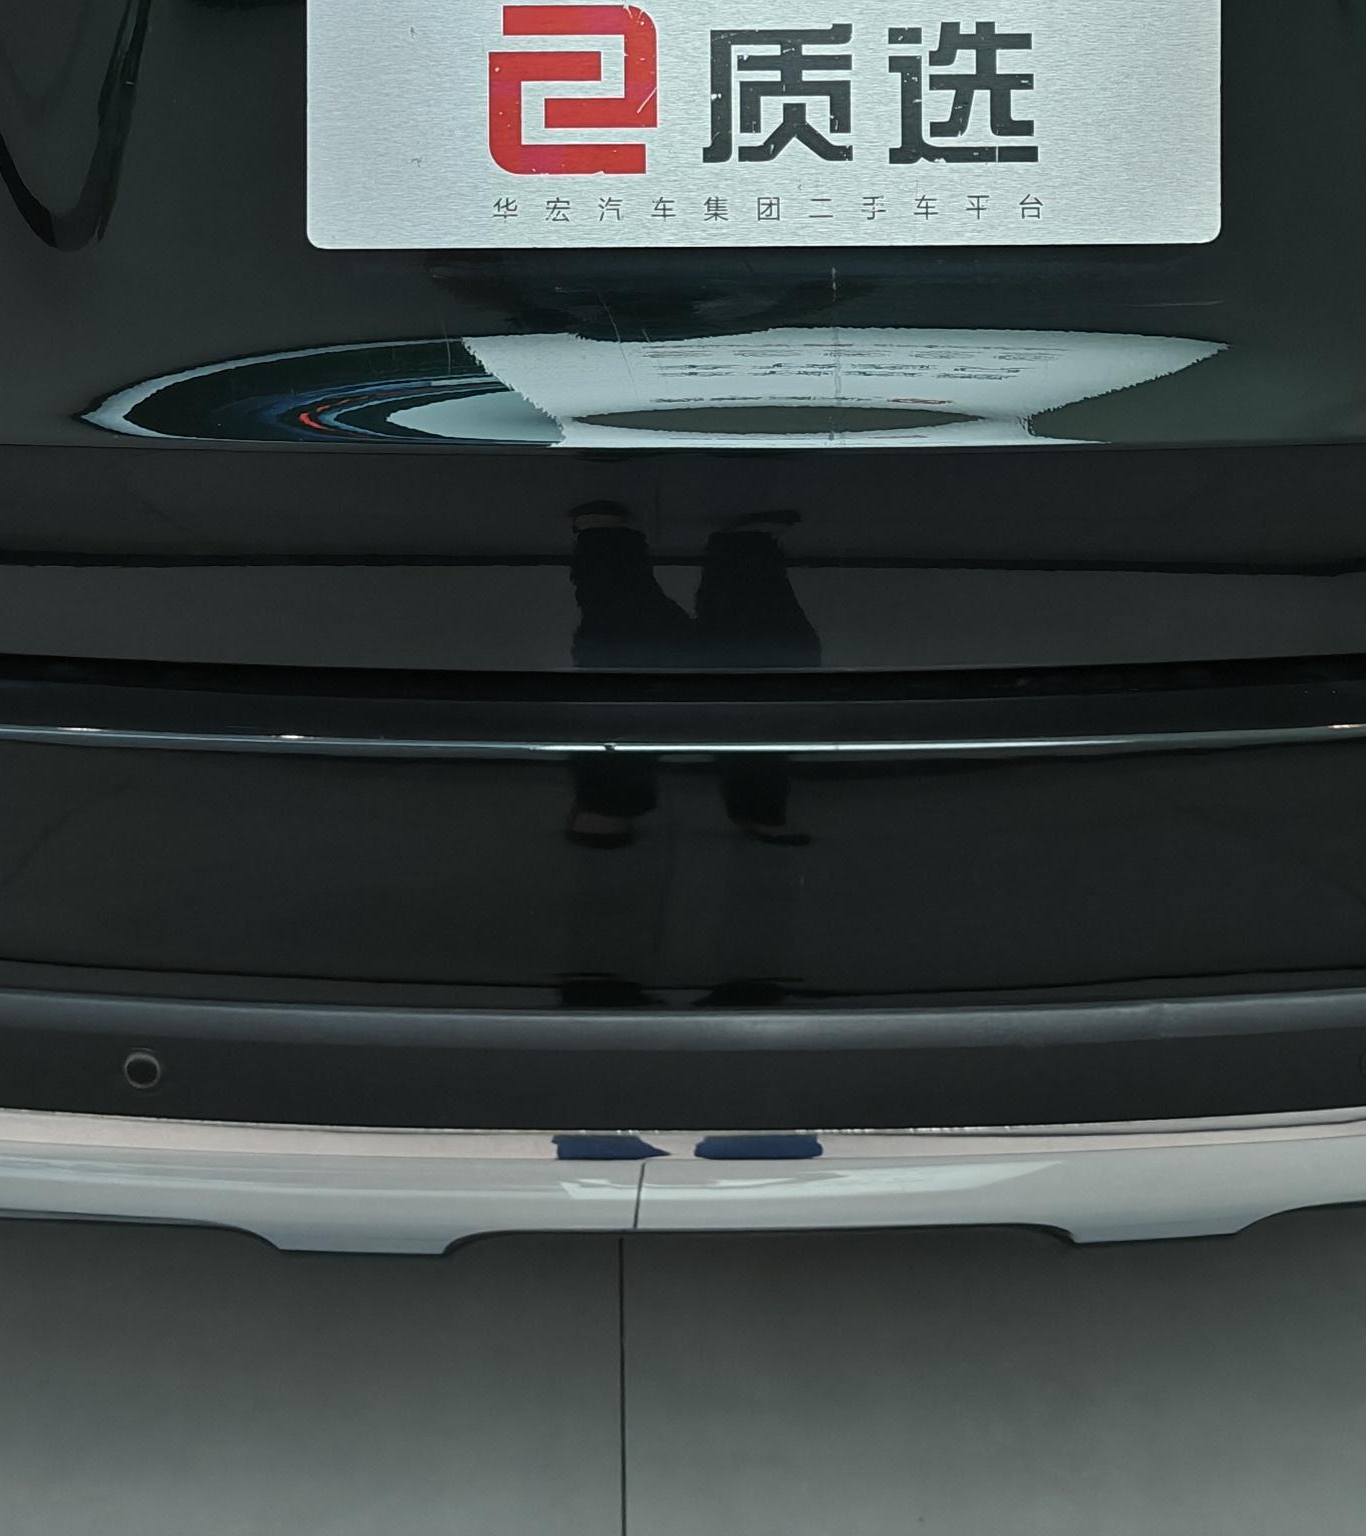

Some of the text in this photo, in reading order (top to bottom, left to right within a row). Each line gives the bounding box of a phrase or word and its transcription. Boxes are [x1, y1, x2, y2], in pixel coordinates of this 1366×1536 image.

[702, 20, 1039, 163] 质选
[491, 196, 1045, 224] 华宏汽车集团二手车平台
